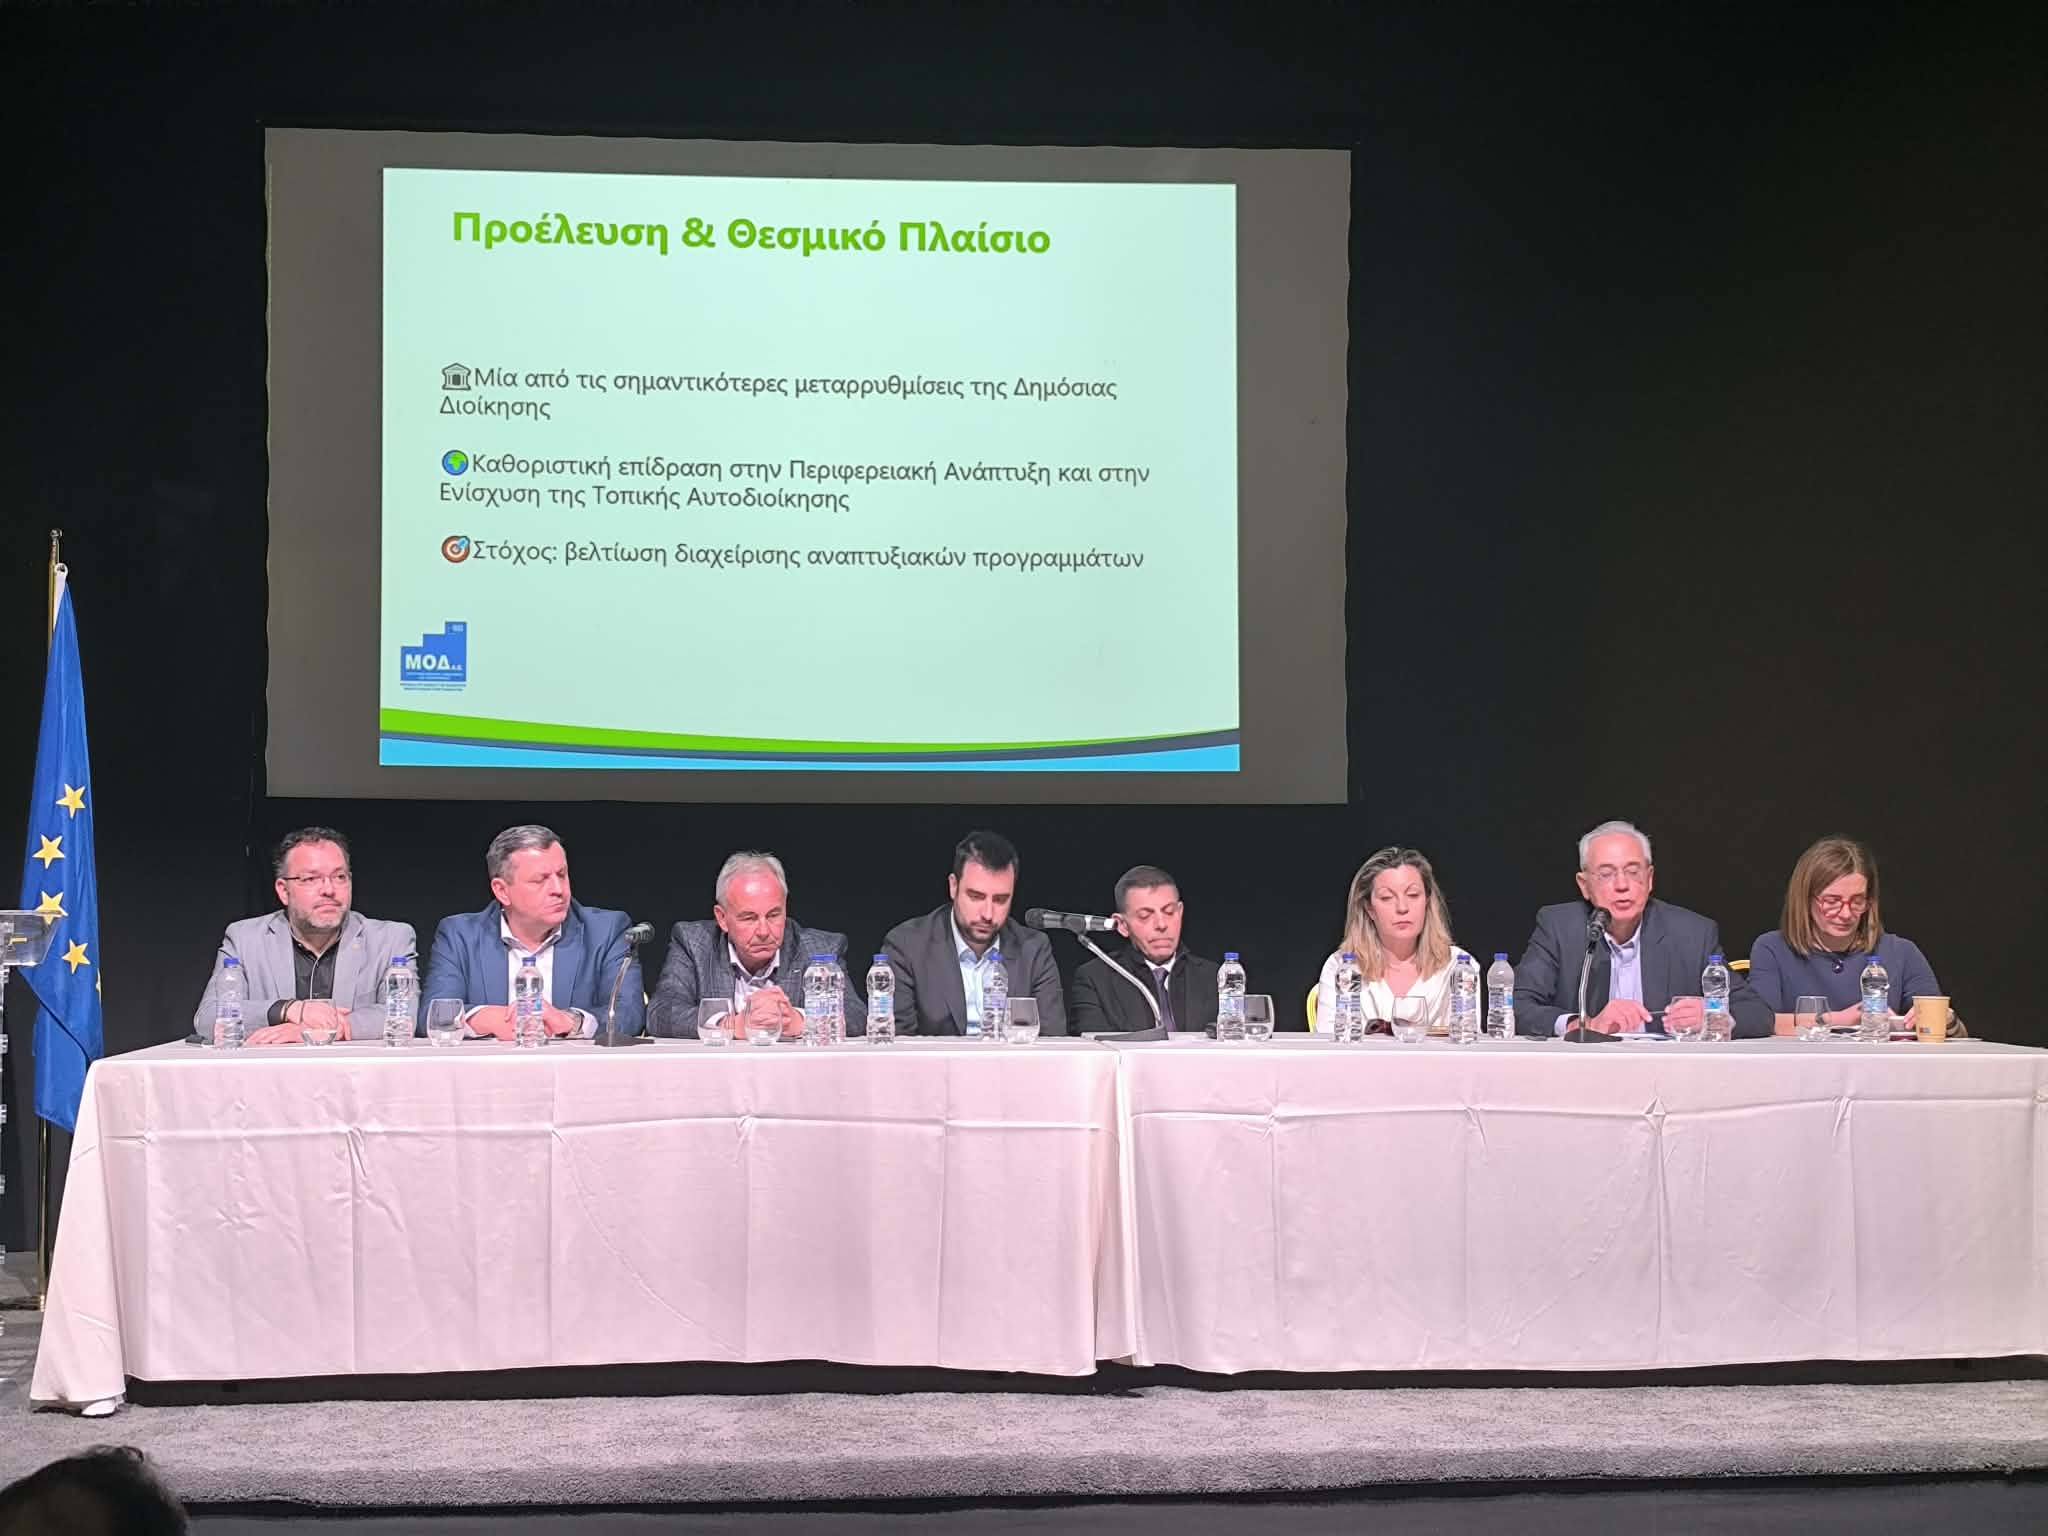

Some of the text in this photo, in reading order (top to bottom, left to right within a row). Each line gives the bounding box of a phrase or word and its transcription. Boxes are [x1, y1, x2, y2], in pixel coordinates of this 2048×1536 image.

[454, 212, 1050, 257] Προέλευση & Θεσμικό Πλαίσιο
[475, 368, 1117, 402] Μία από τις σημαντικότερες μεταρρυθμίσεις της Δημόσιας
[440, 394, 550, 421] Διοίκησης
[472, 454, 1149, 487] Καθοριστική επίδραση στην Περιφερειακή Ανάπτυξη και στην
[440, 482, 850, 513] Ενίσχυση της Τοπικής Αυτοδιοίκησης
[473, 540, 1143, 572] Στόχος: βελτίωση διαχείρισης αναπτυξιακών προγραμμάτων
